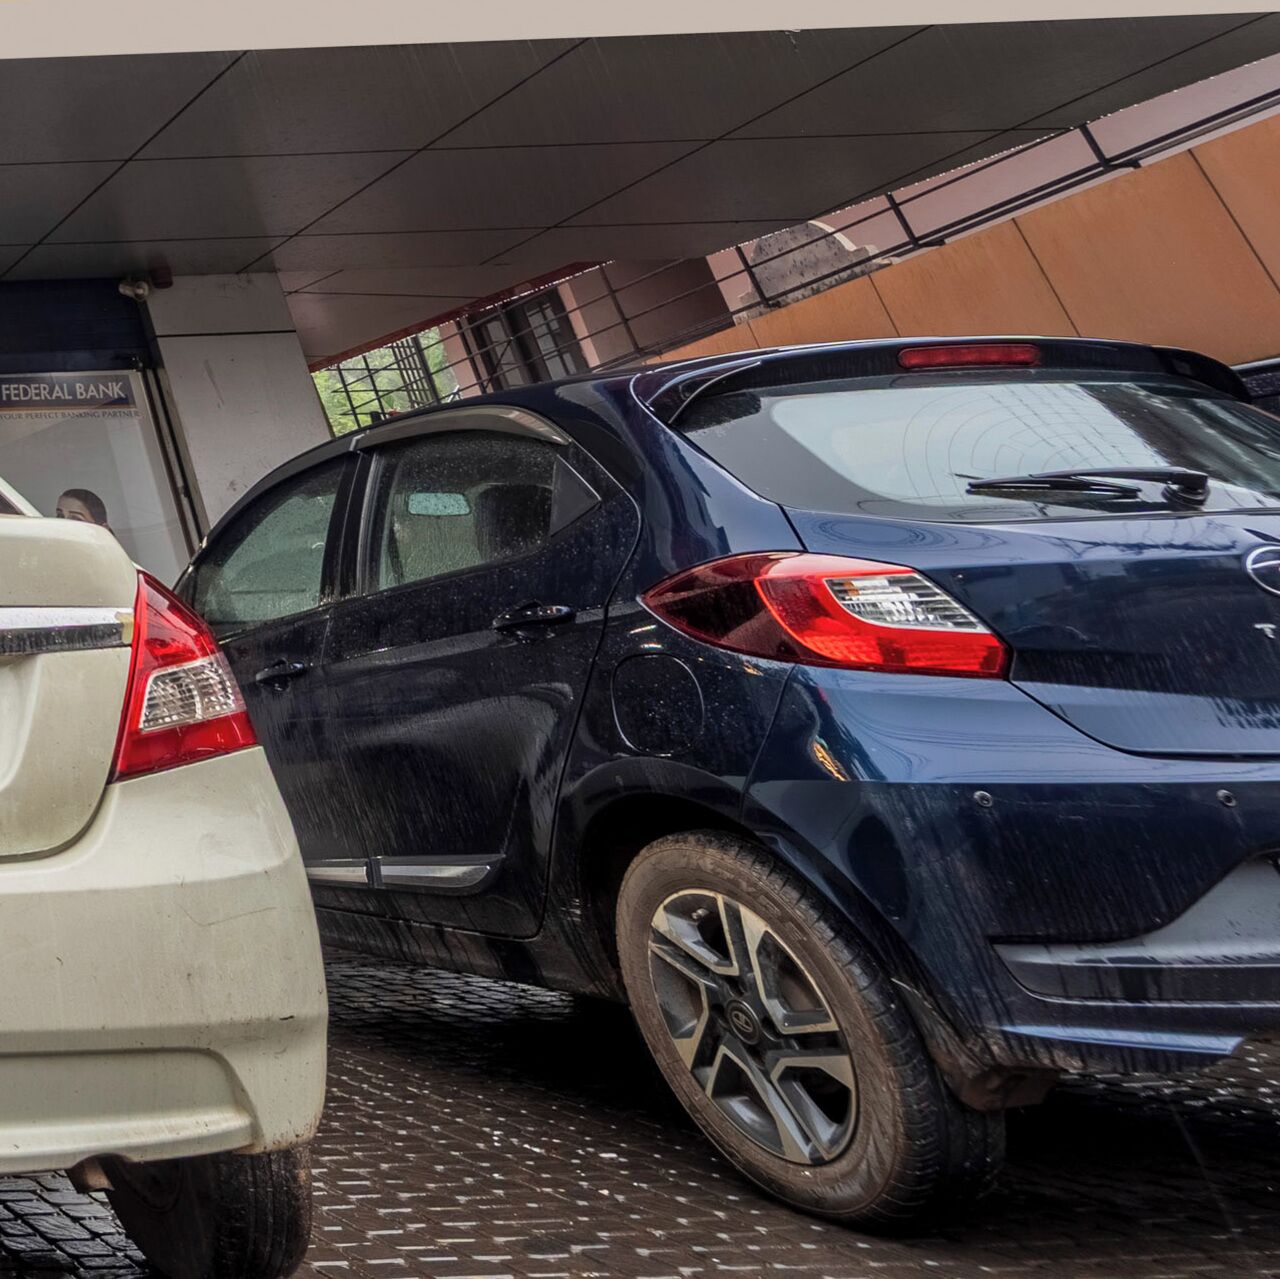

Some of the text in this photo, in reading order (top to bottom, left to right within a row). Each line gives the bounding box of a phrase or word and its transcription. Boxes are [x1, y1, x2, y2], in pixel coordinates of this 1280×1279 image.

[2, 382, 126, 401] FEDERAL BANK
[0, 410, 140, 420] YOUR PERFECT BANKING PARTNER
